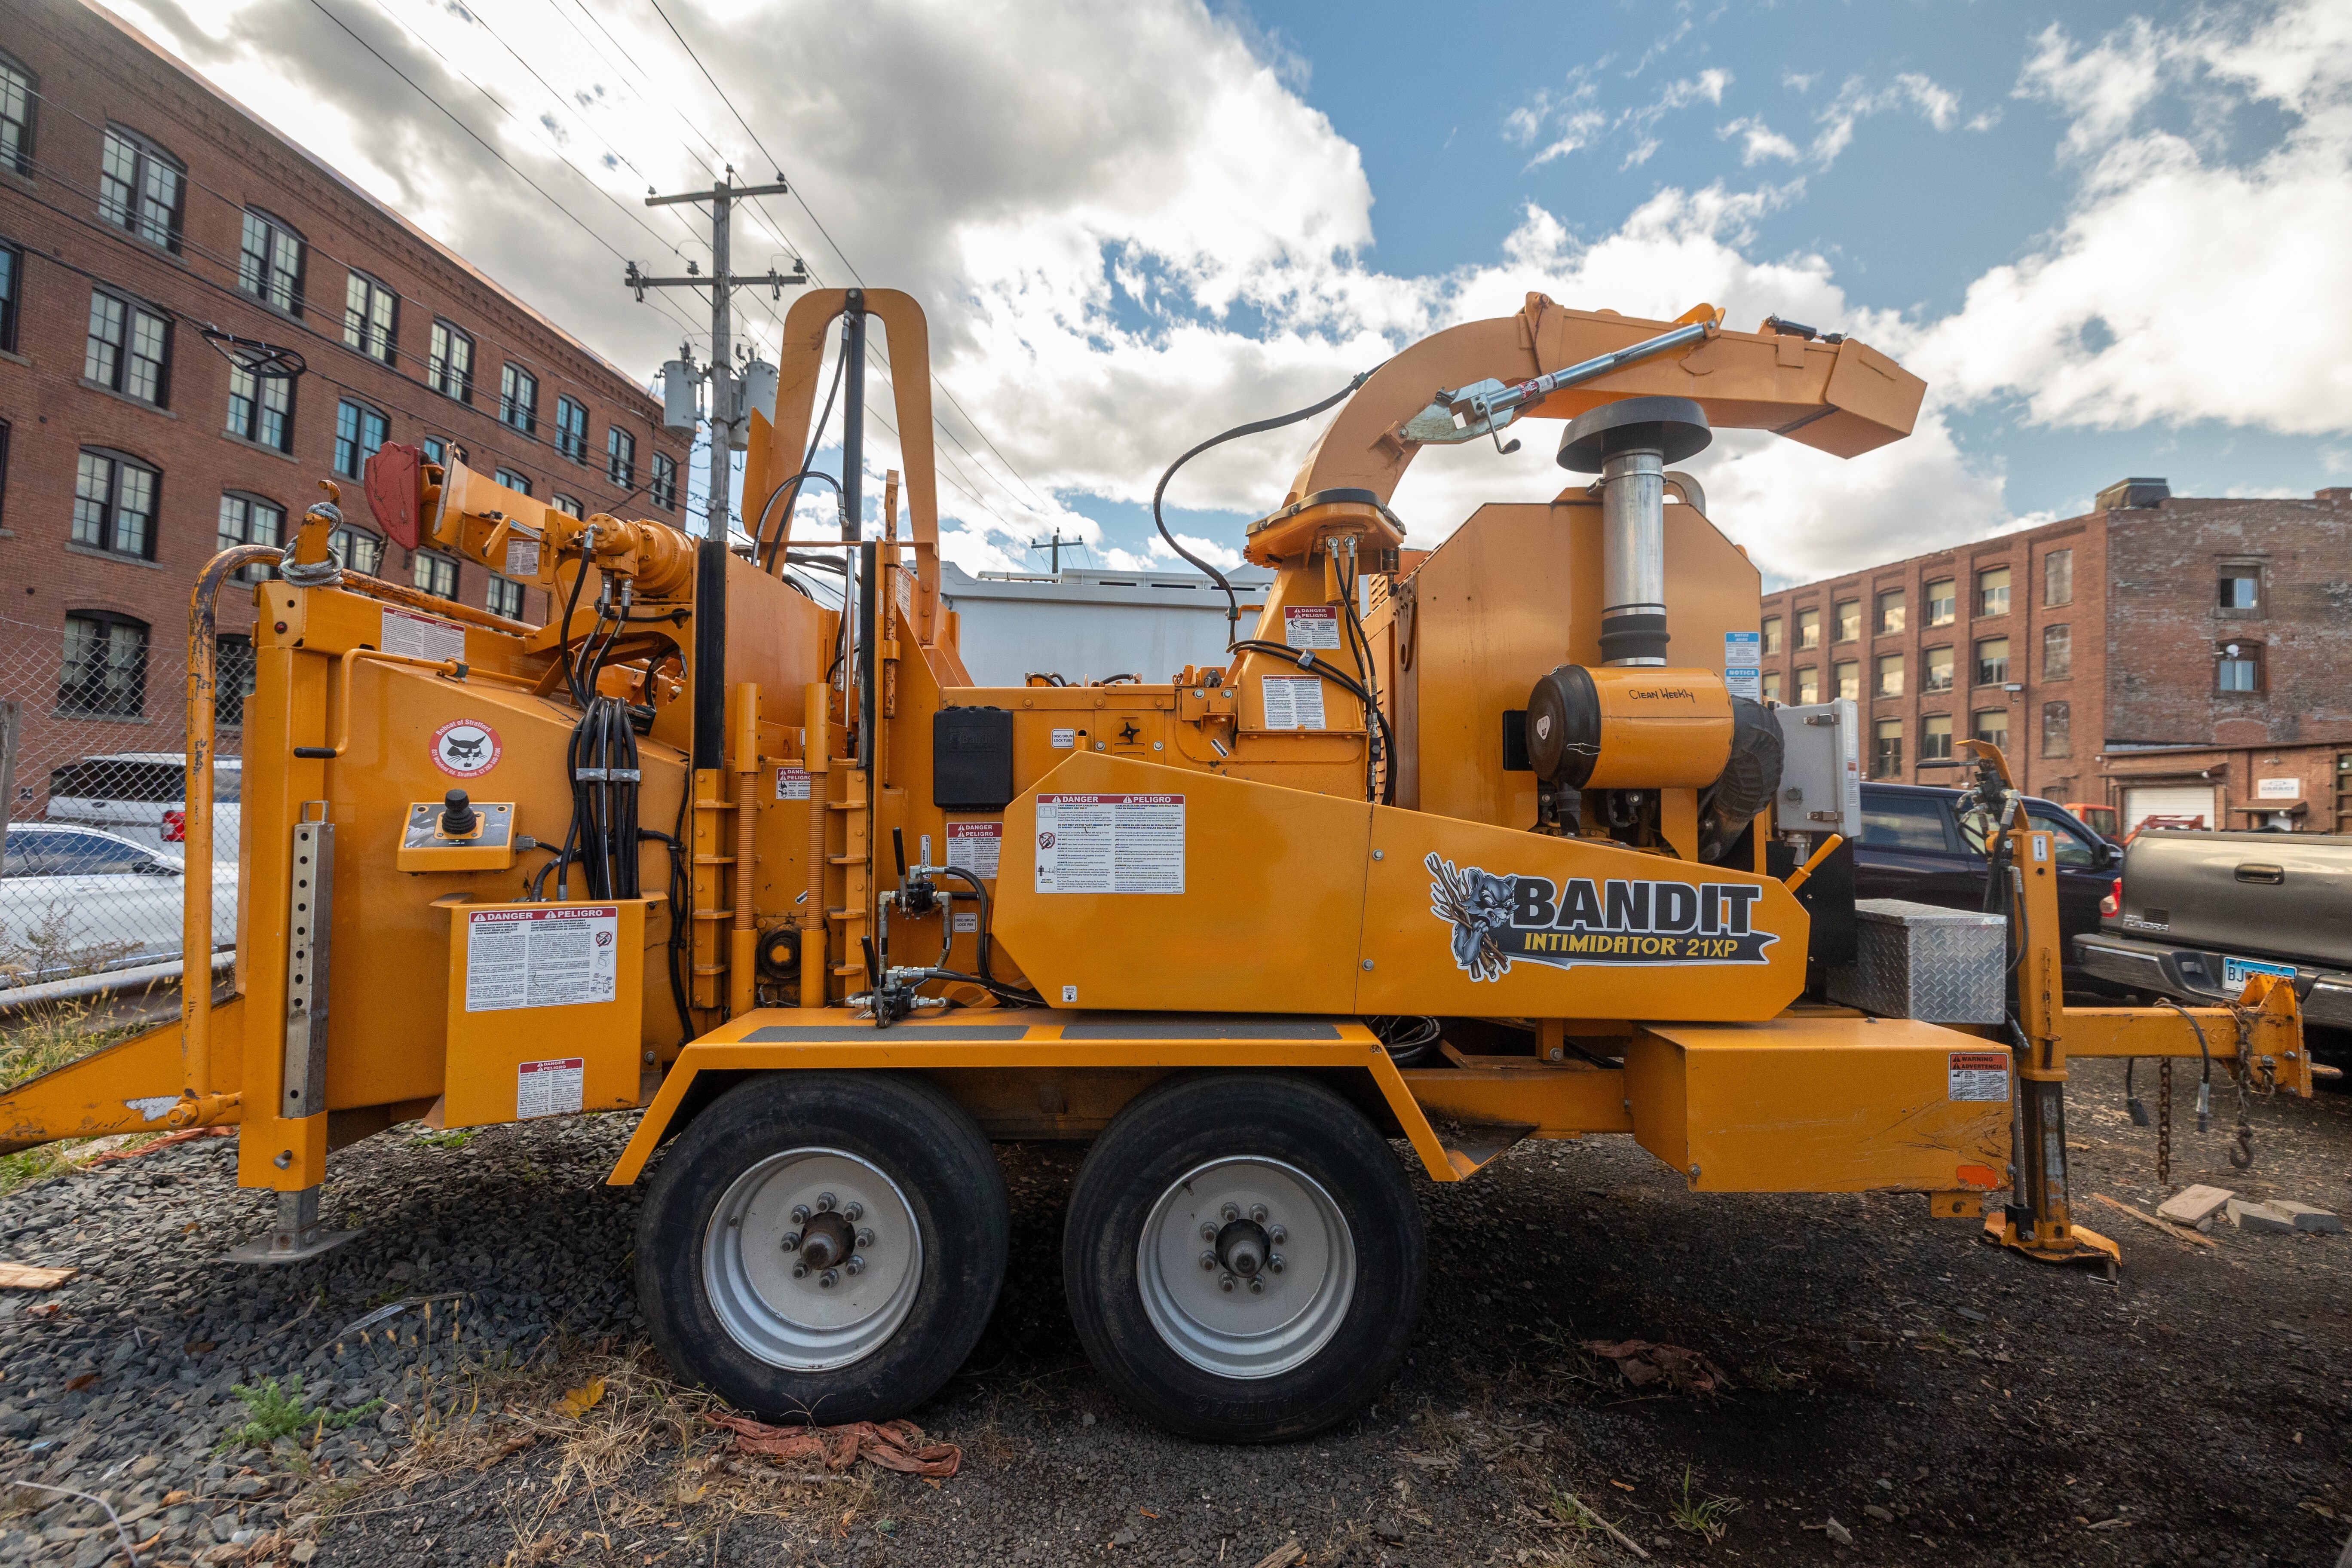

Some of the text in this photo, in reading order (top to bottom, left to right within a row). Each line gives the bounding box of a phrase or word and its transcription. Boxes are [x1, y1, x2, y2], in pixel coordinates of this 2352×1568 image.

[435, 721, 456, 735] Bobcat
[465, 719, 492, 732] Stratford
[1514, 876, 1759, 933] BANDIT
[487, 910, 603, 920] DANGER PELIGRO
[1687, 939, 1737, 957] 21XP
[2243, 962, 2275, 971] Connecticut
